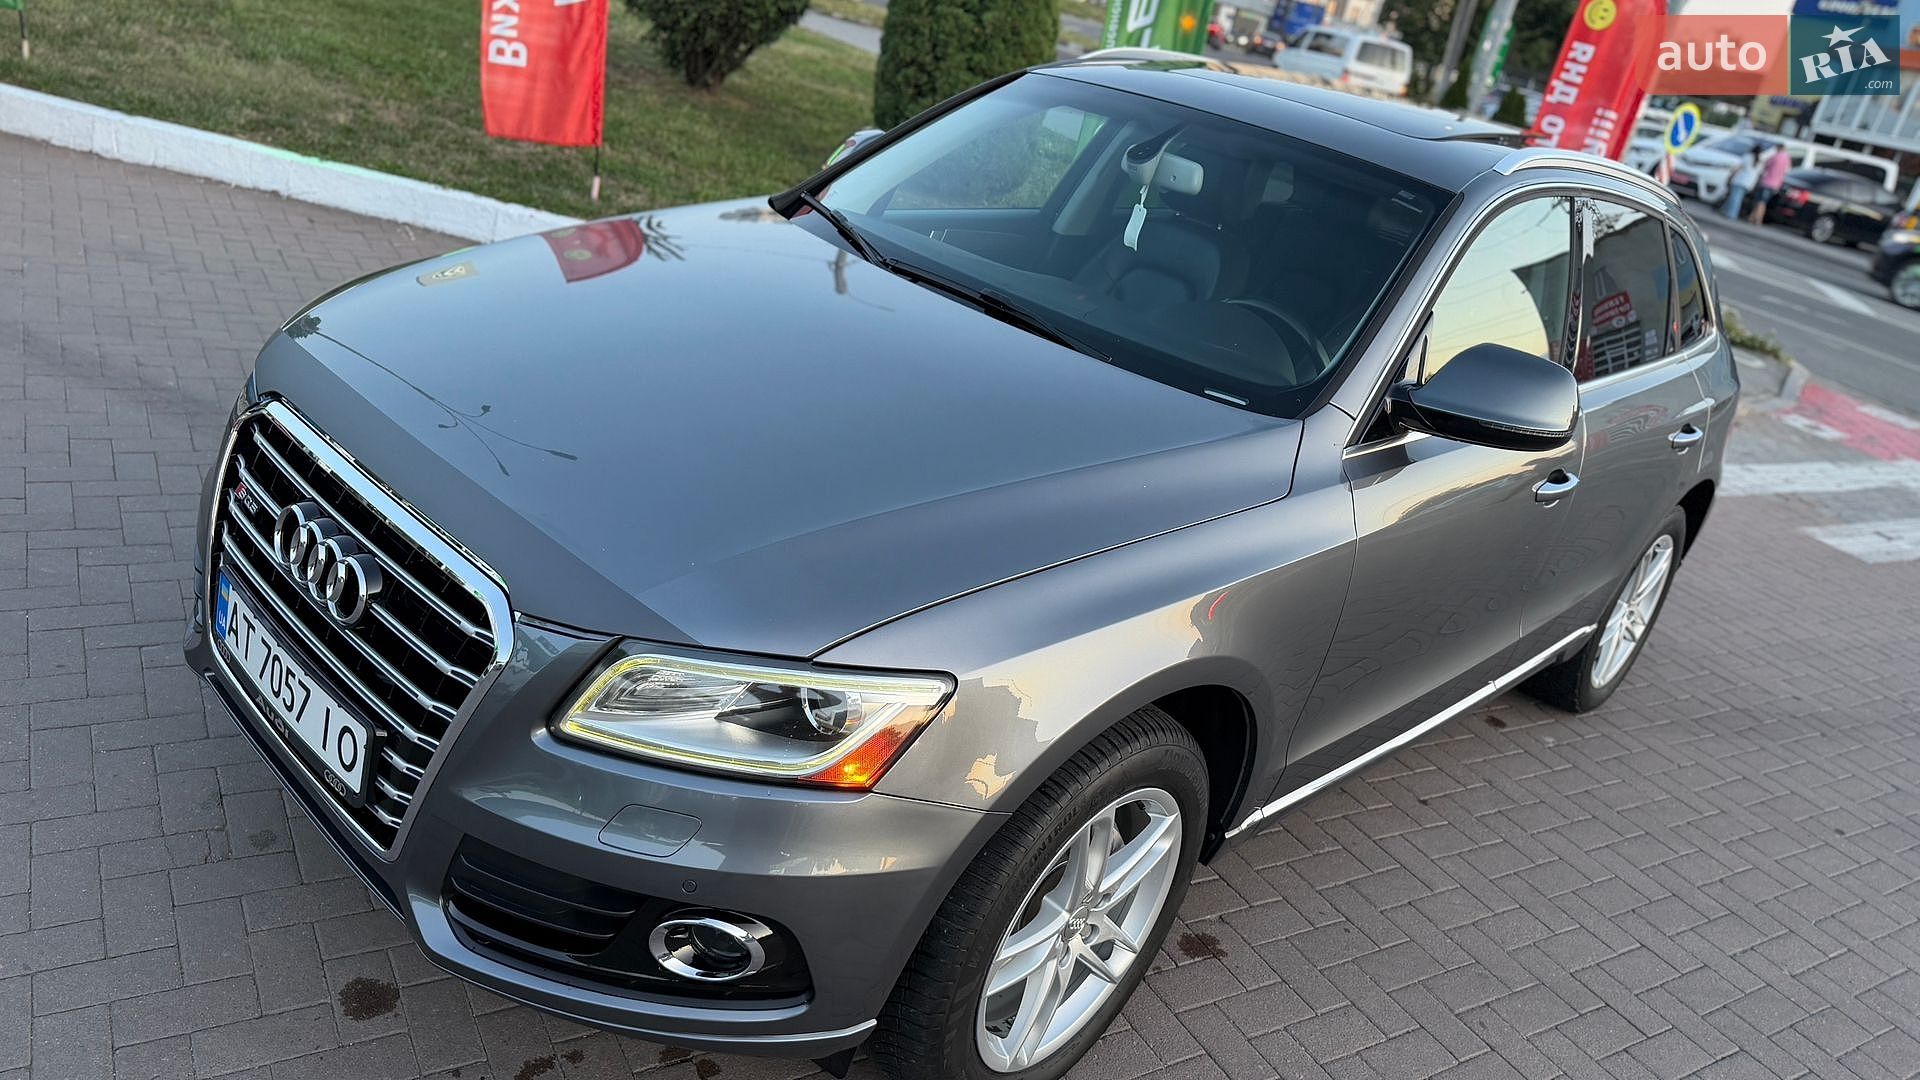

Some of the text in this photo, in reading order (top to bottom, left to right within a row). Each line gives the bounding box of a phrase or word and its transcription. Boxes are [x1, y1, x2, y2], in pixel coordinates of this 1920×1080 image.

[218, 612, 227, 631] UA
[228, 603, 256, 661] AT
[259, 636, 312, 723] 7057
